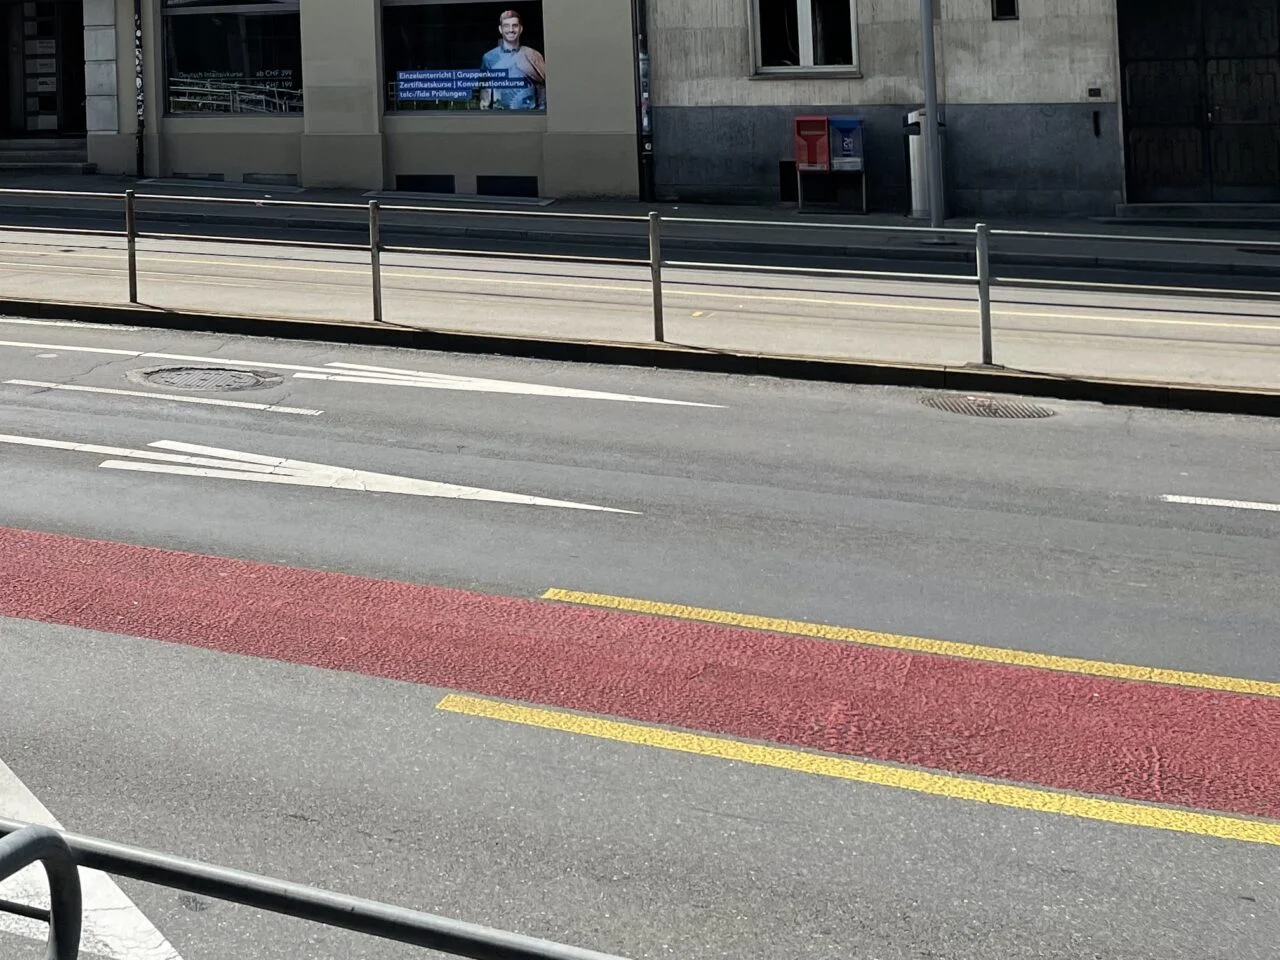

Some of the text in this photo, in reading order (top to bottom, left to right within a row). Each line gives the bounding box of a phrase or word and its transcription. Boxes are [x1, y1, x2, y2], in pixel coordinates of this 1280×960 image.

[399, 70, 506, 80] Einzelunterricht Gruppenkurse
[399, 80, 525, 89] Zertifikatskurse Konversationskurse
[431, 89, 467, 99] Prüfungen
